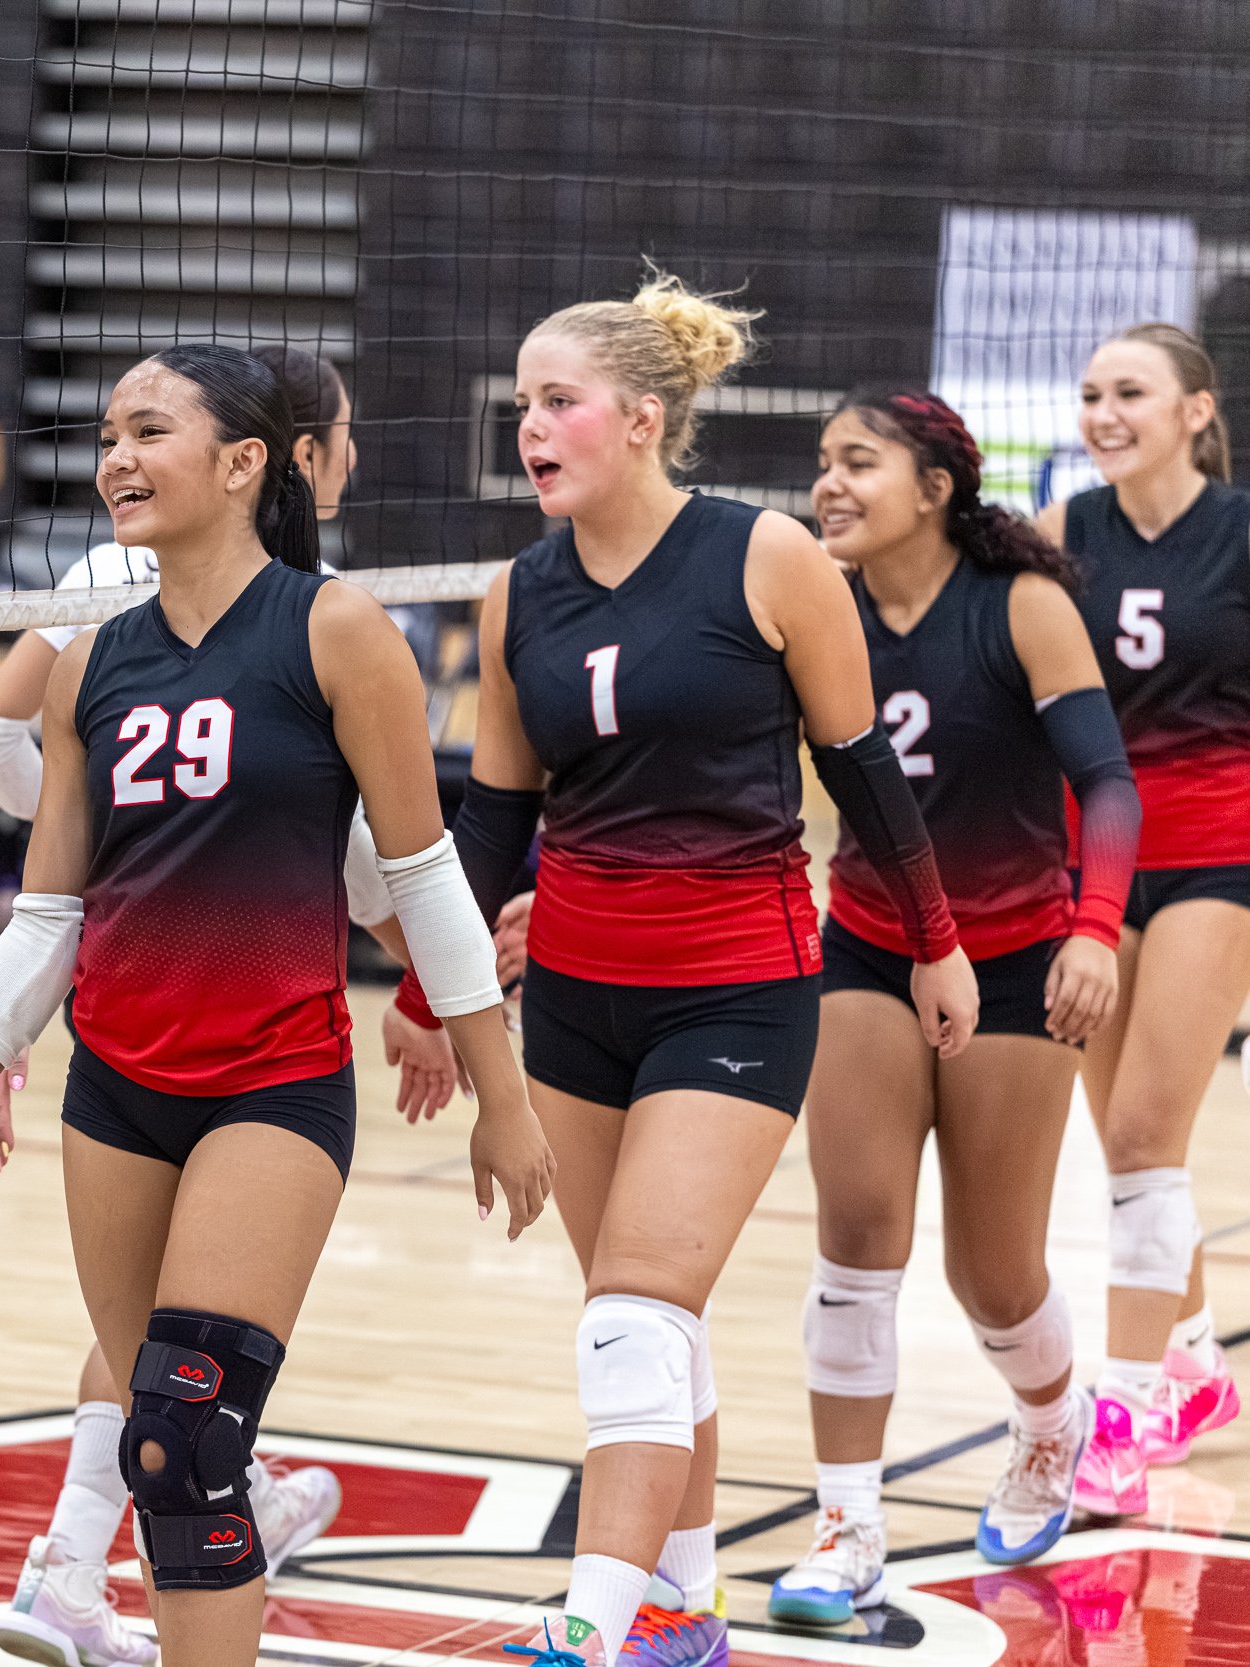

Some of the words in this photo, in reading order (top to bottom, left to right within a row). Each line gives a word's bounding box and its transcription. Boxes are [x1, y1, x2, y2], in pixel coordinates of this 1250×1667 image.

[1115, 588, 1165, 670] 5
[583, 643, 621, 737] 1
[883, 689, 935, 777] 2
[111, 696, 235, 808] 29
